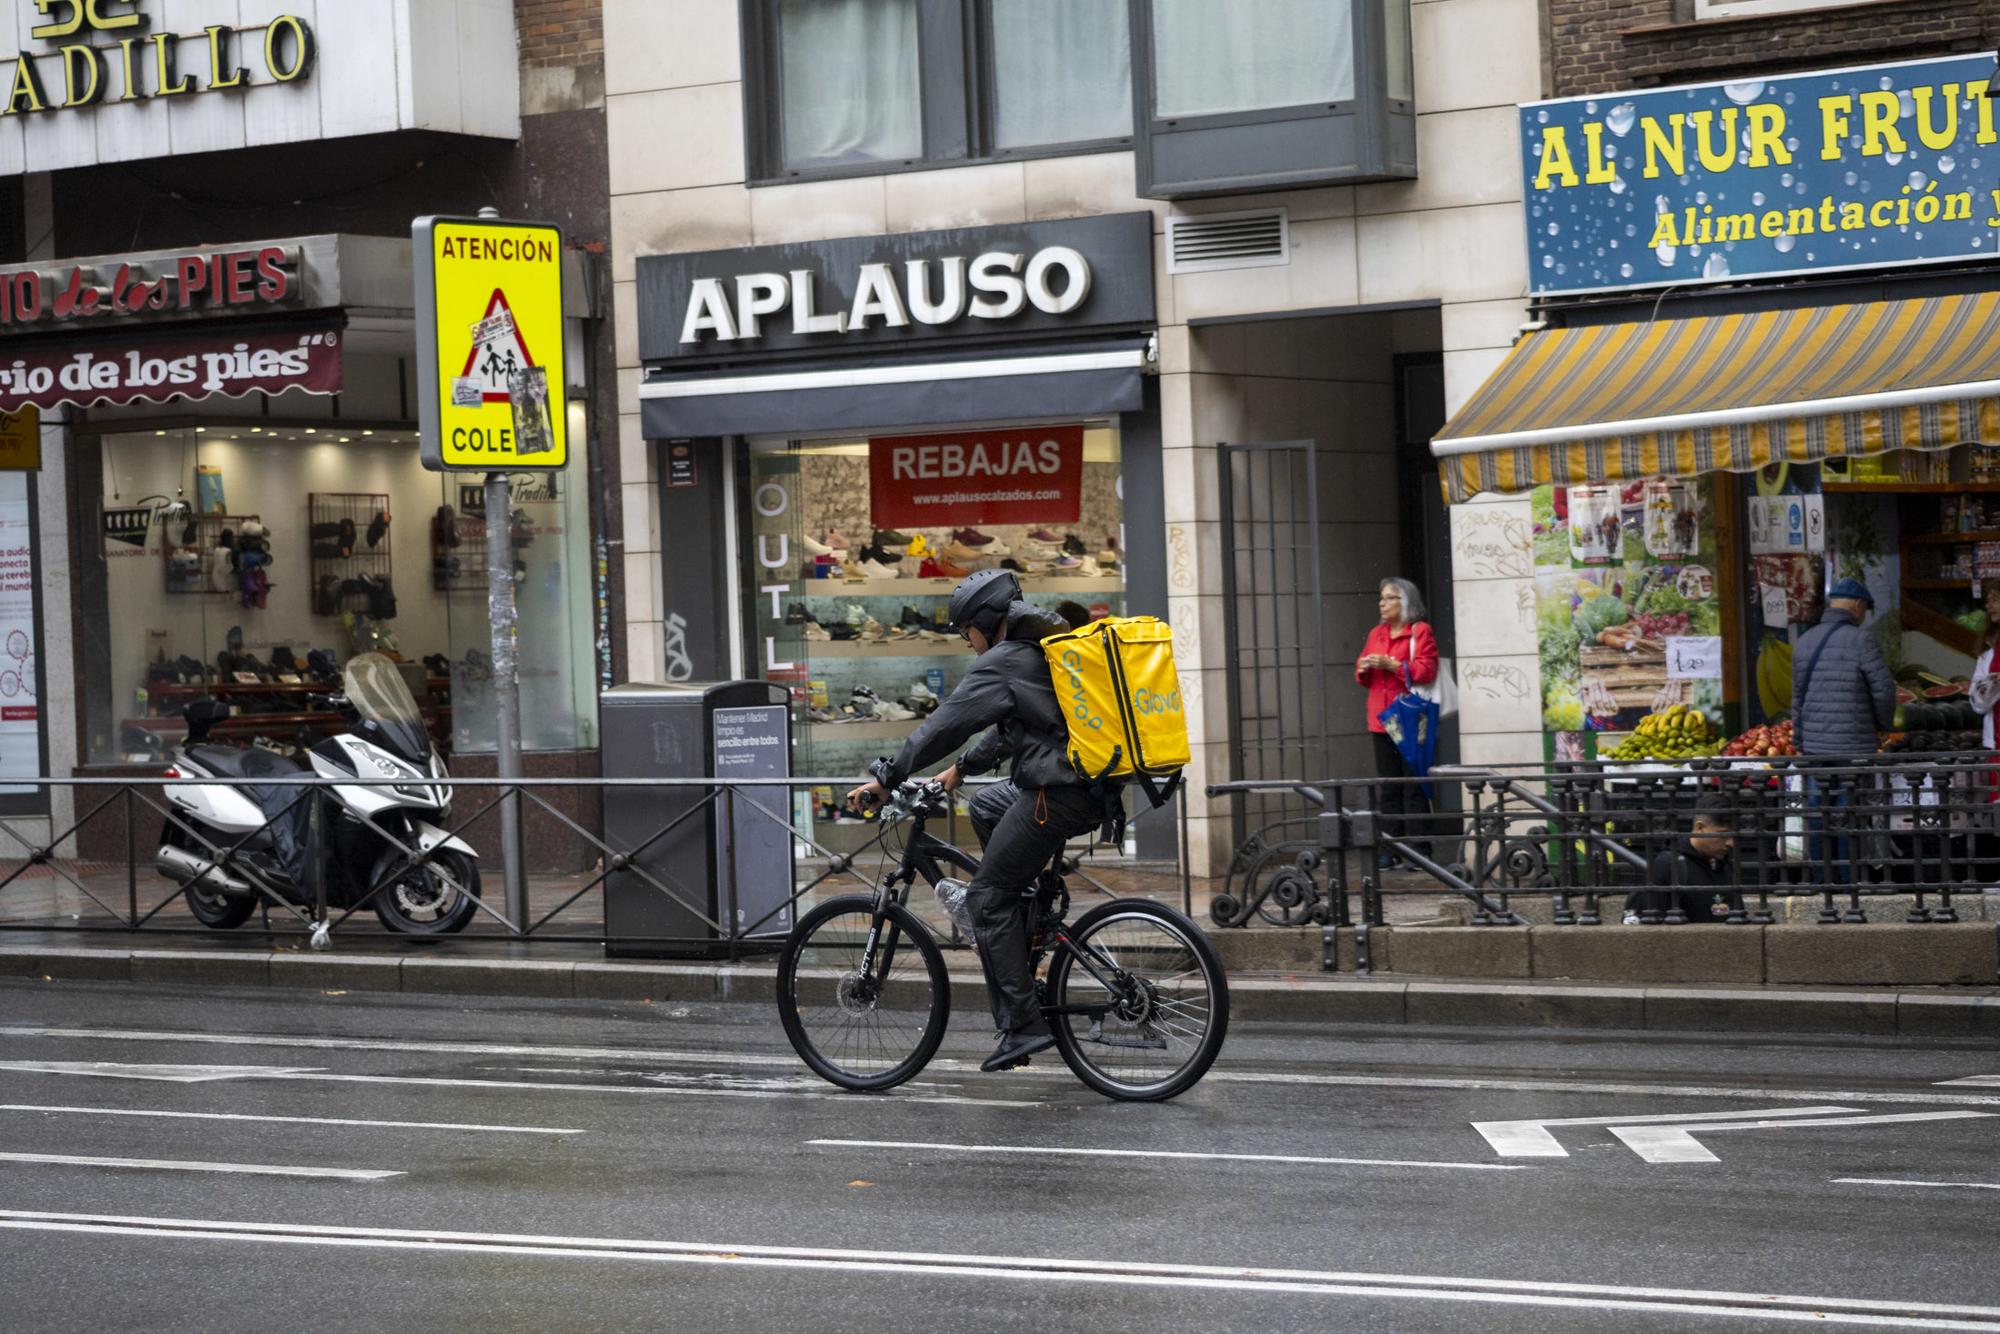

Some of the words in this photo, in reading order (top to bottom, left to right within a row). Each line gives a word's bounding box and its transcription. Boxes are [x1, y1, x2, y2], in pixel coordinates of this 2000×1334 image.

[1534, 122, 1616, 190] AL
[1640, 103, 1792, 178] NUR
[442, 235, 552, 262] ATENCIÓN
[1647, 181, 1973, 249] Alimentación
[53, 265, 102, 317] de
[112, 263, 168, 312] los
[178, 247, 288, 308] PIES
[679, 246, 1091, 343] APLAUSO
[59, 353, 119, 391] de
[125, 351, 197, 388] los
[892, 440, 1061, 480] REBAJAS
[1061, 649, 1090, 720] Glovo
